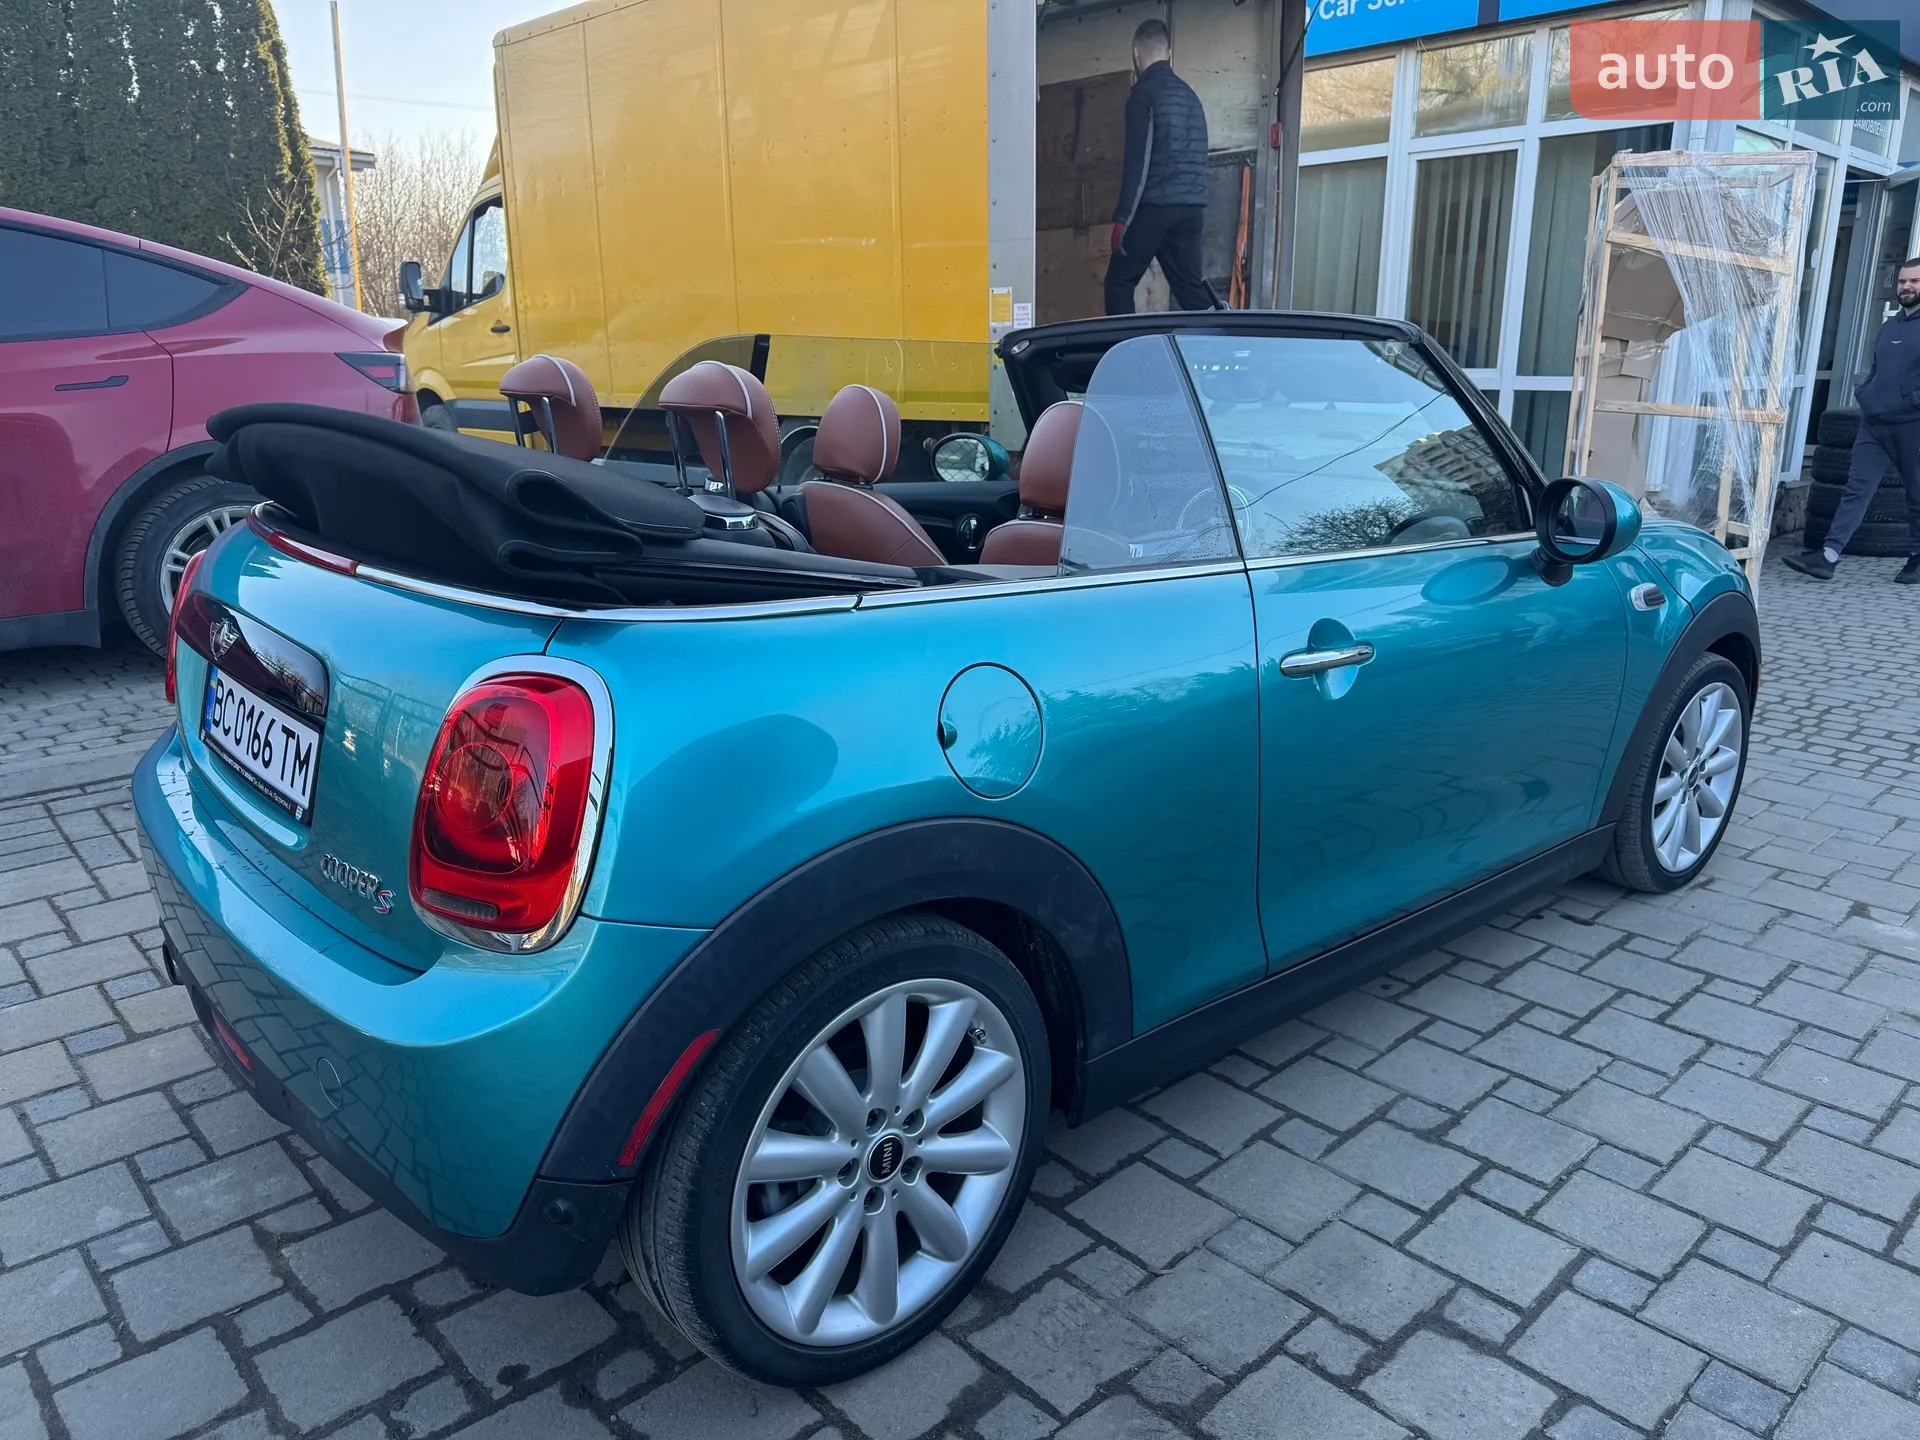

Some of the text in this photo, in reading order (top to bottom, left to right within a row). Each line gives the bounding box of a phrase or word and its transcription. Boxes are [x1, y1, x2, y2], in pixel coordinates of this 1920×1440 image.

[1319, 0, 1360, 20] Car
[281, 724, 313, 797] TM
[320, 853, 381, 902] COOPER
[881, 1142, 893, 1174] MINI
